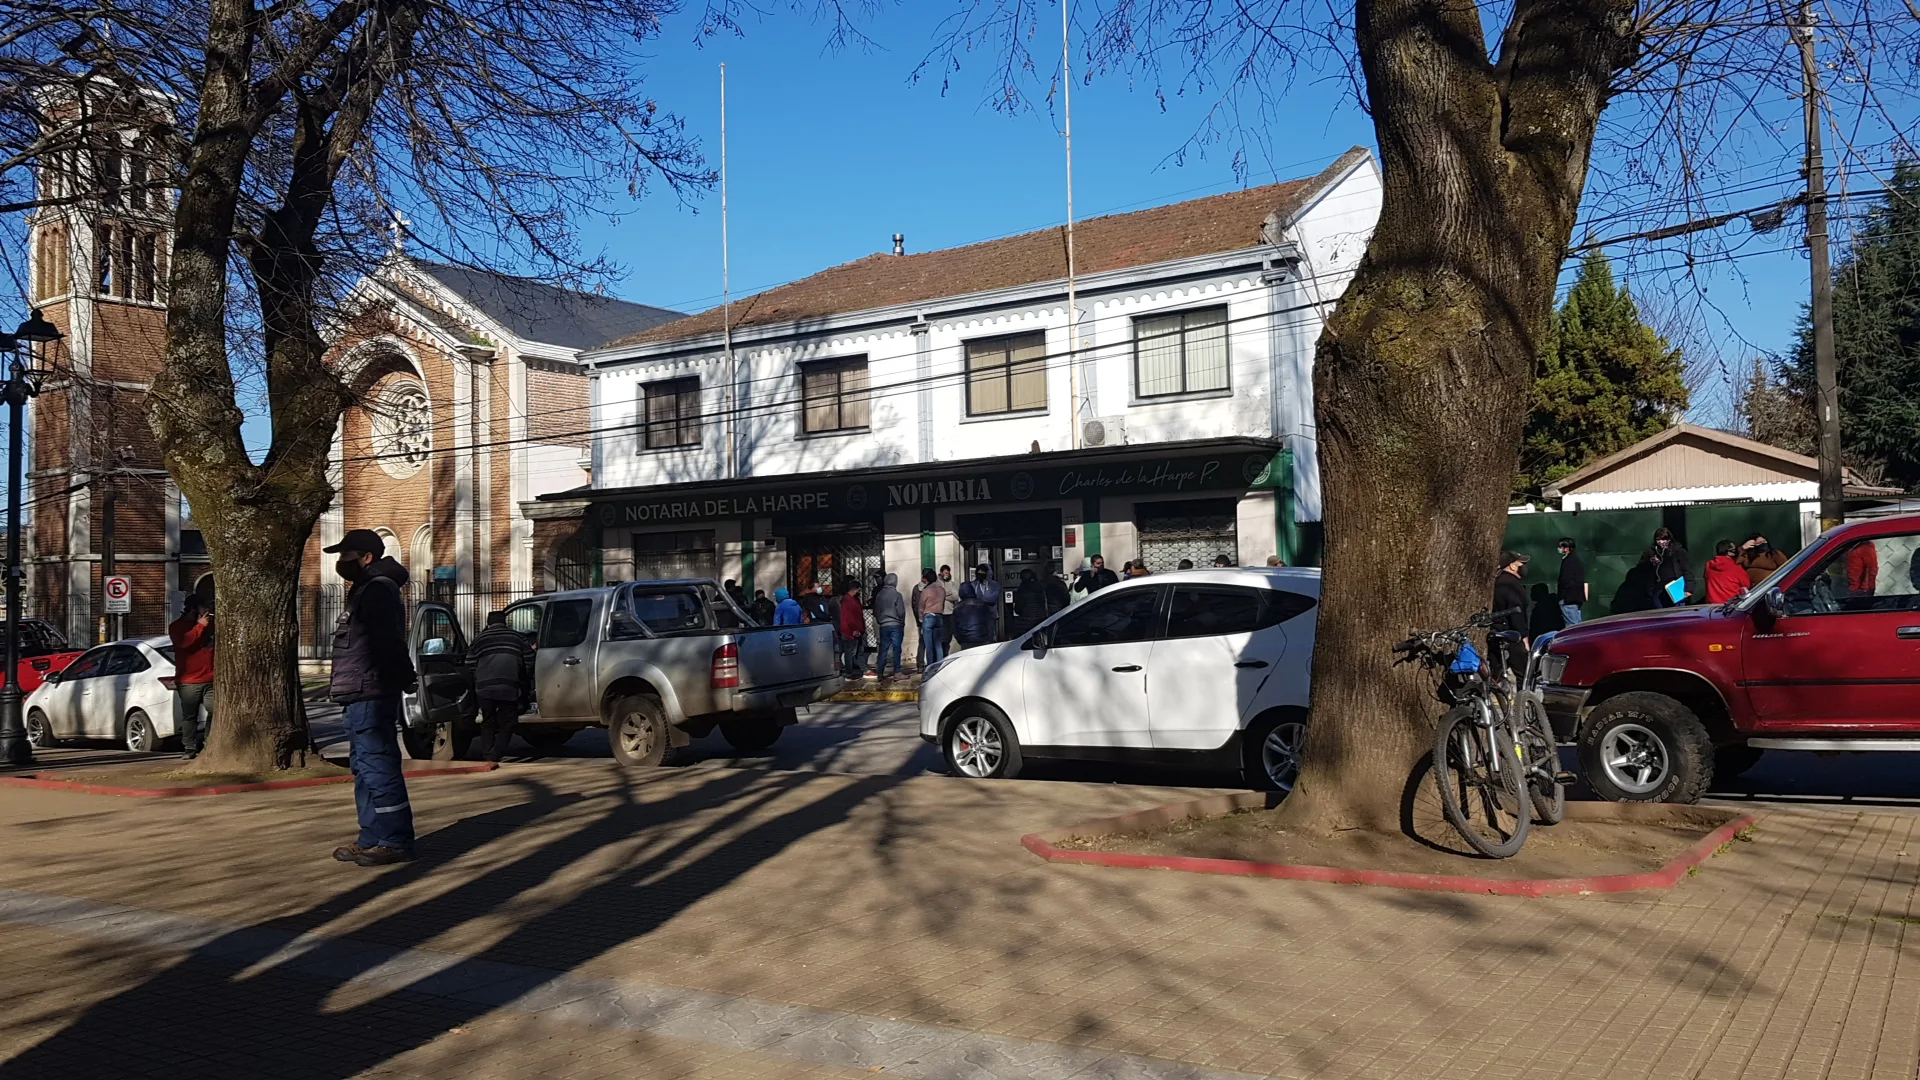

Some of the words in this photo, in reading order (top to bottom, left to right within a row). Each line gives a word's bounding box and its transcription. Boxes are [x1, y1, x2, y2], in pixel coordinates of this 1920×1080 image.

[888, 478, 992, 506] NOTARIA
[1059, 468, 1112, 494] Charles
[1116, 468, 1134, 485] de
[1137, 466, 1148, 484] la
[1146, 461, 1196, 490] Harpe
[625, 501, 701, 521] NOTARIA
[705, 499, 729, 516] DE
[733, 497, 759, 514] LA
[762, 492, 829, 512] HARPE
[1587, 711, 1624, 746] RADIAL
[1628, 710, 1654, 723] M/T
